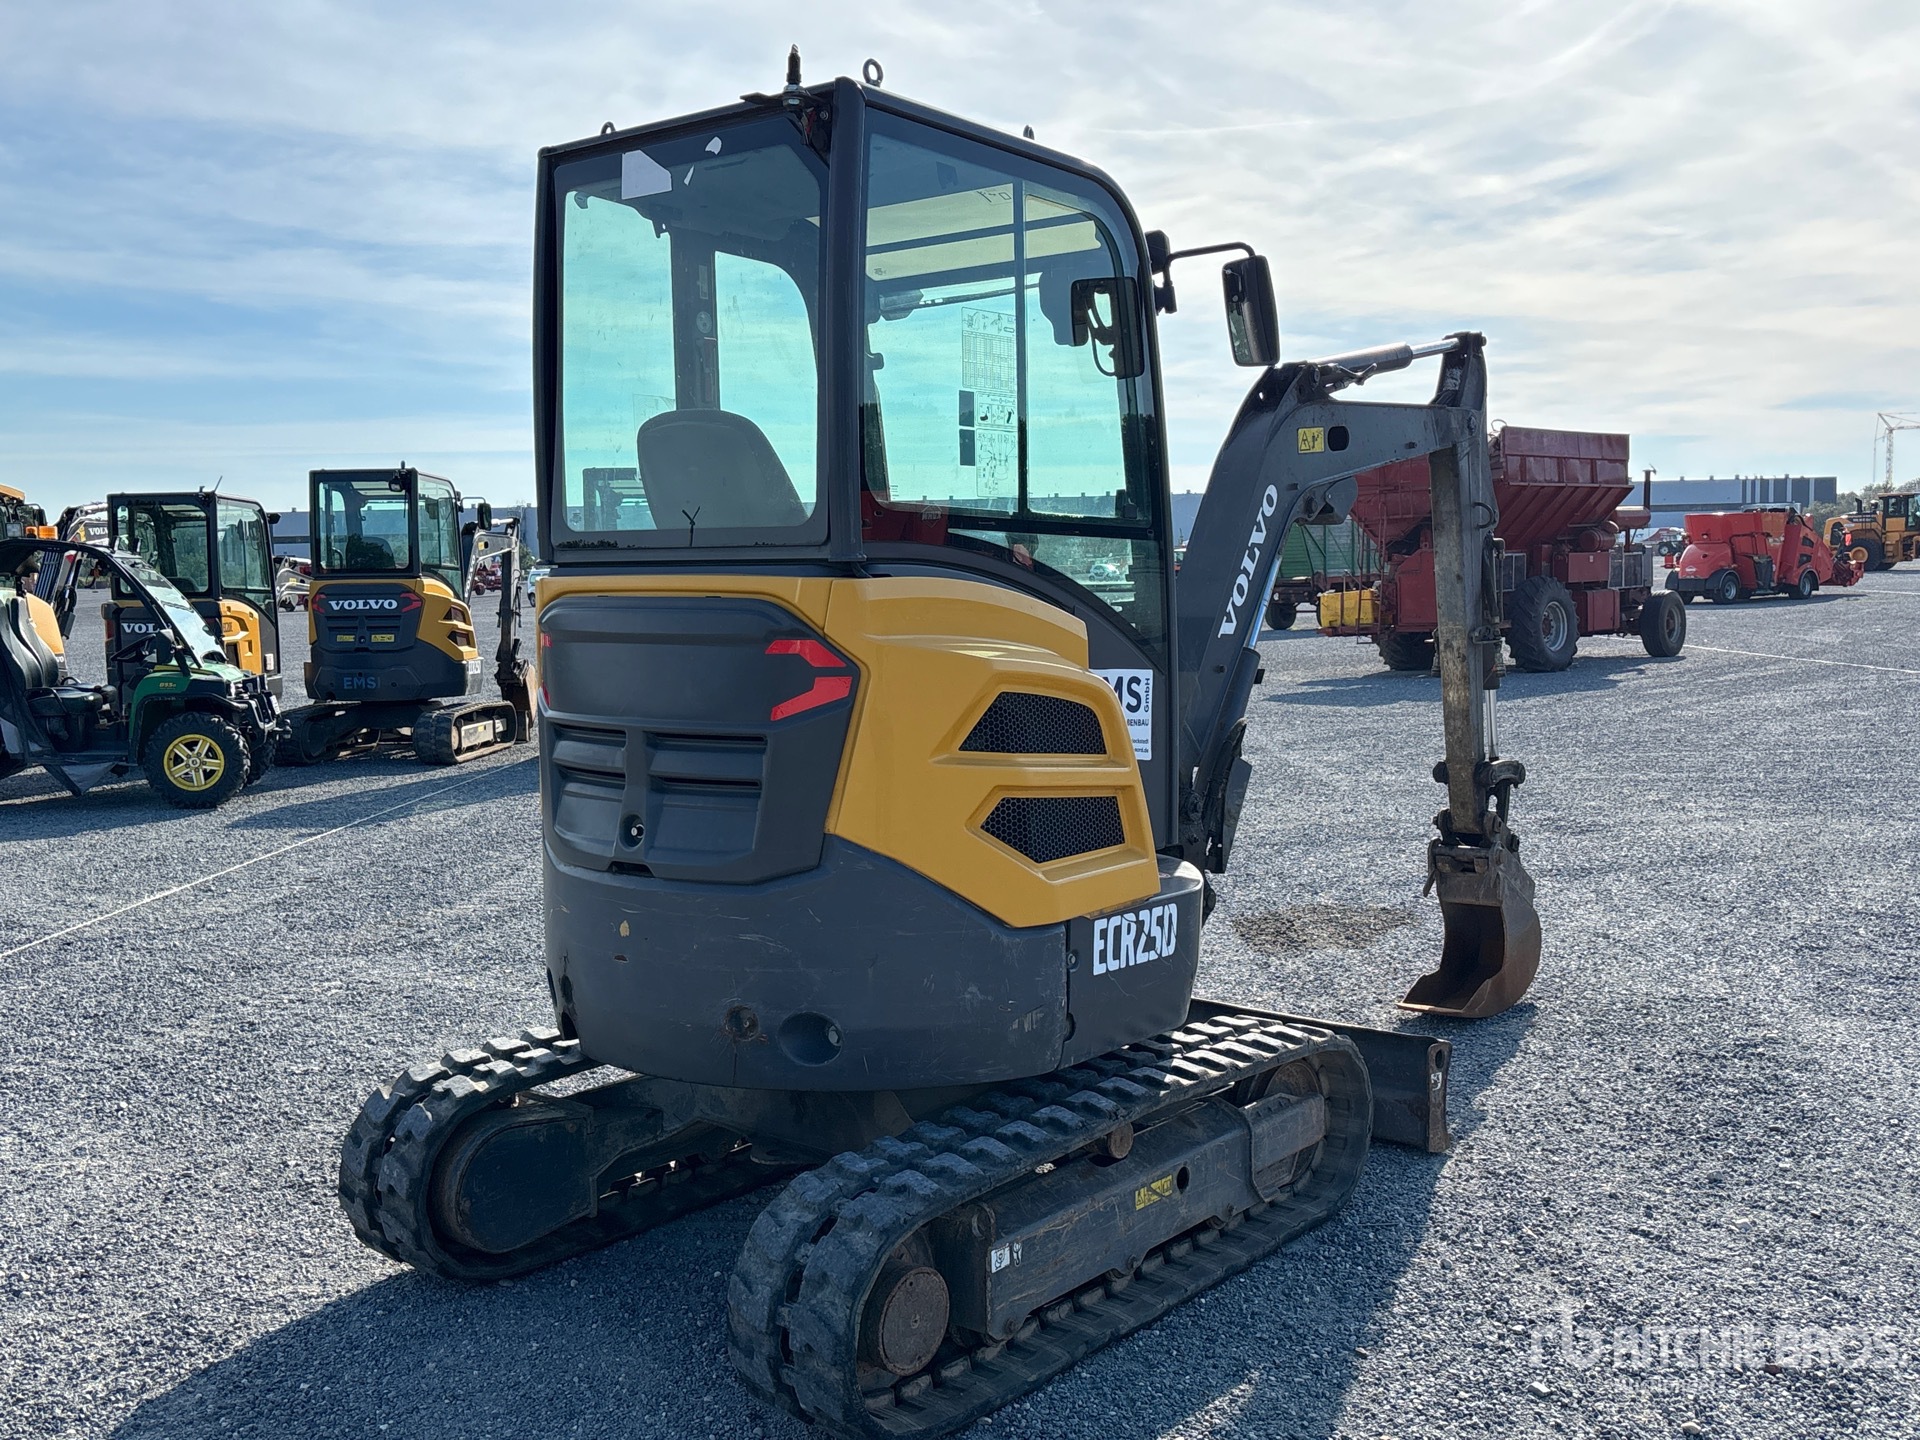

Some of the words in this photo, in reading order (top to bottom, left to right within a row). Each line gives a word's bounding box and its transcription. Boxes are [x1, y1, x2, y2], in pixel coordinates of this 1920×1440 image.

[1217, 484, 1279, 639] VOLVO
[328, 599, 398, 611] VOLVO
[1093, 903, 1178, 976] ECR25D
